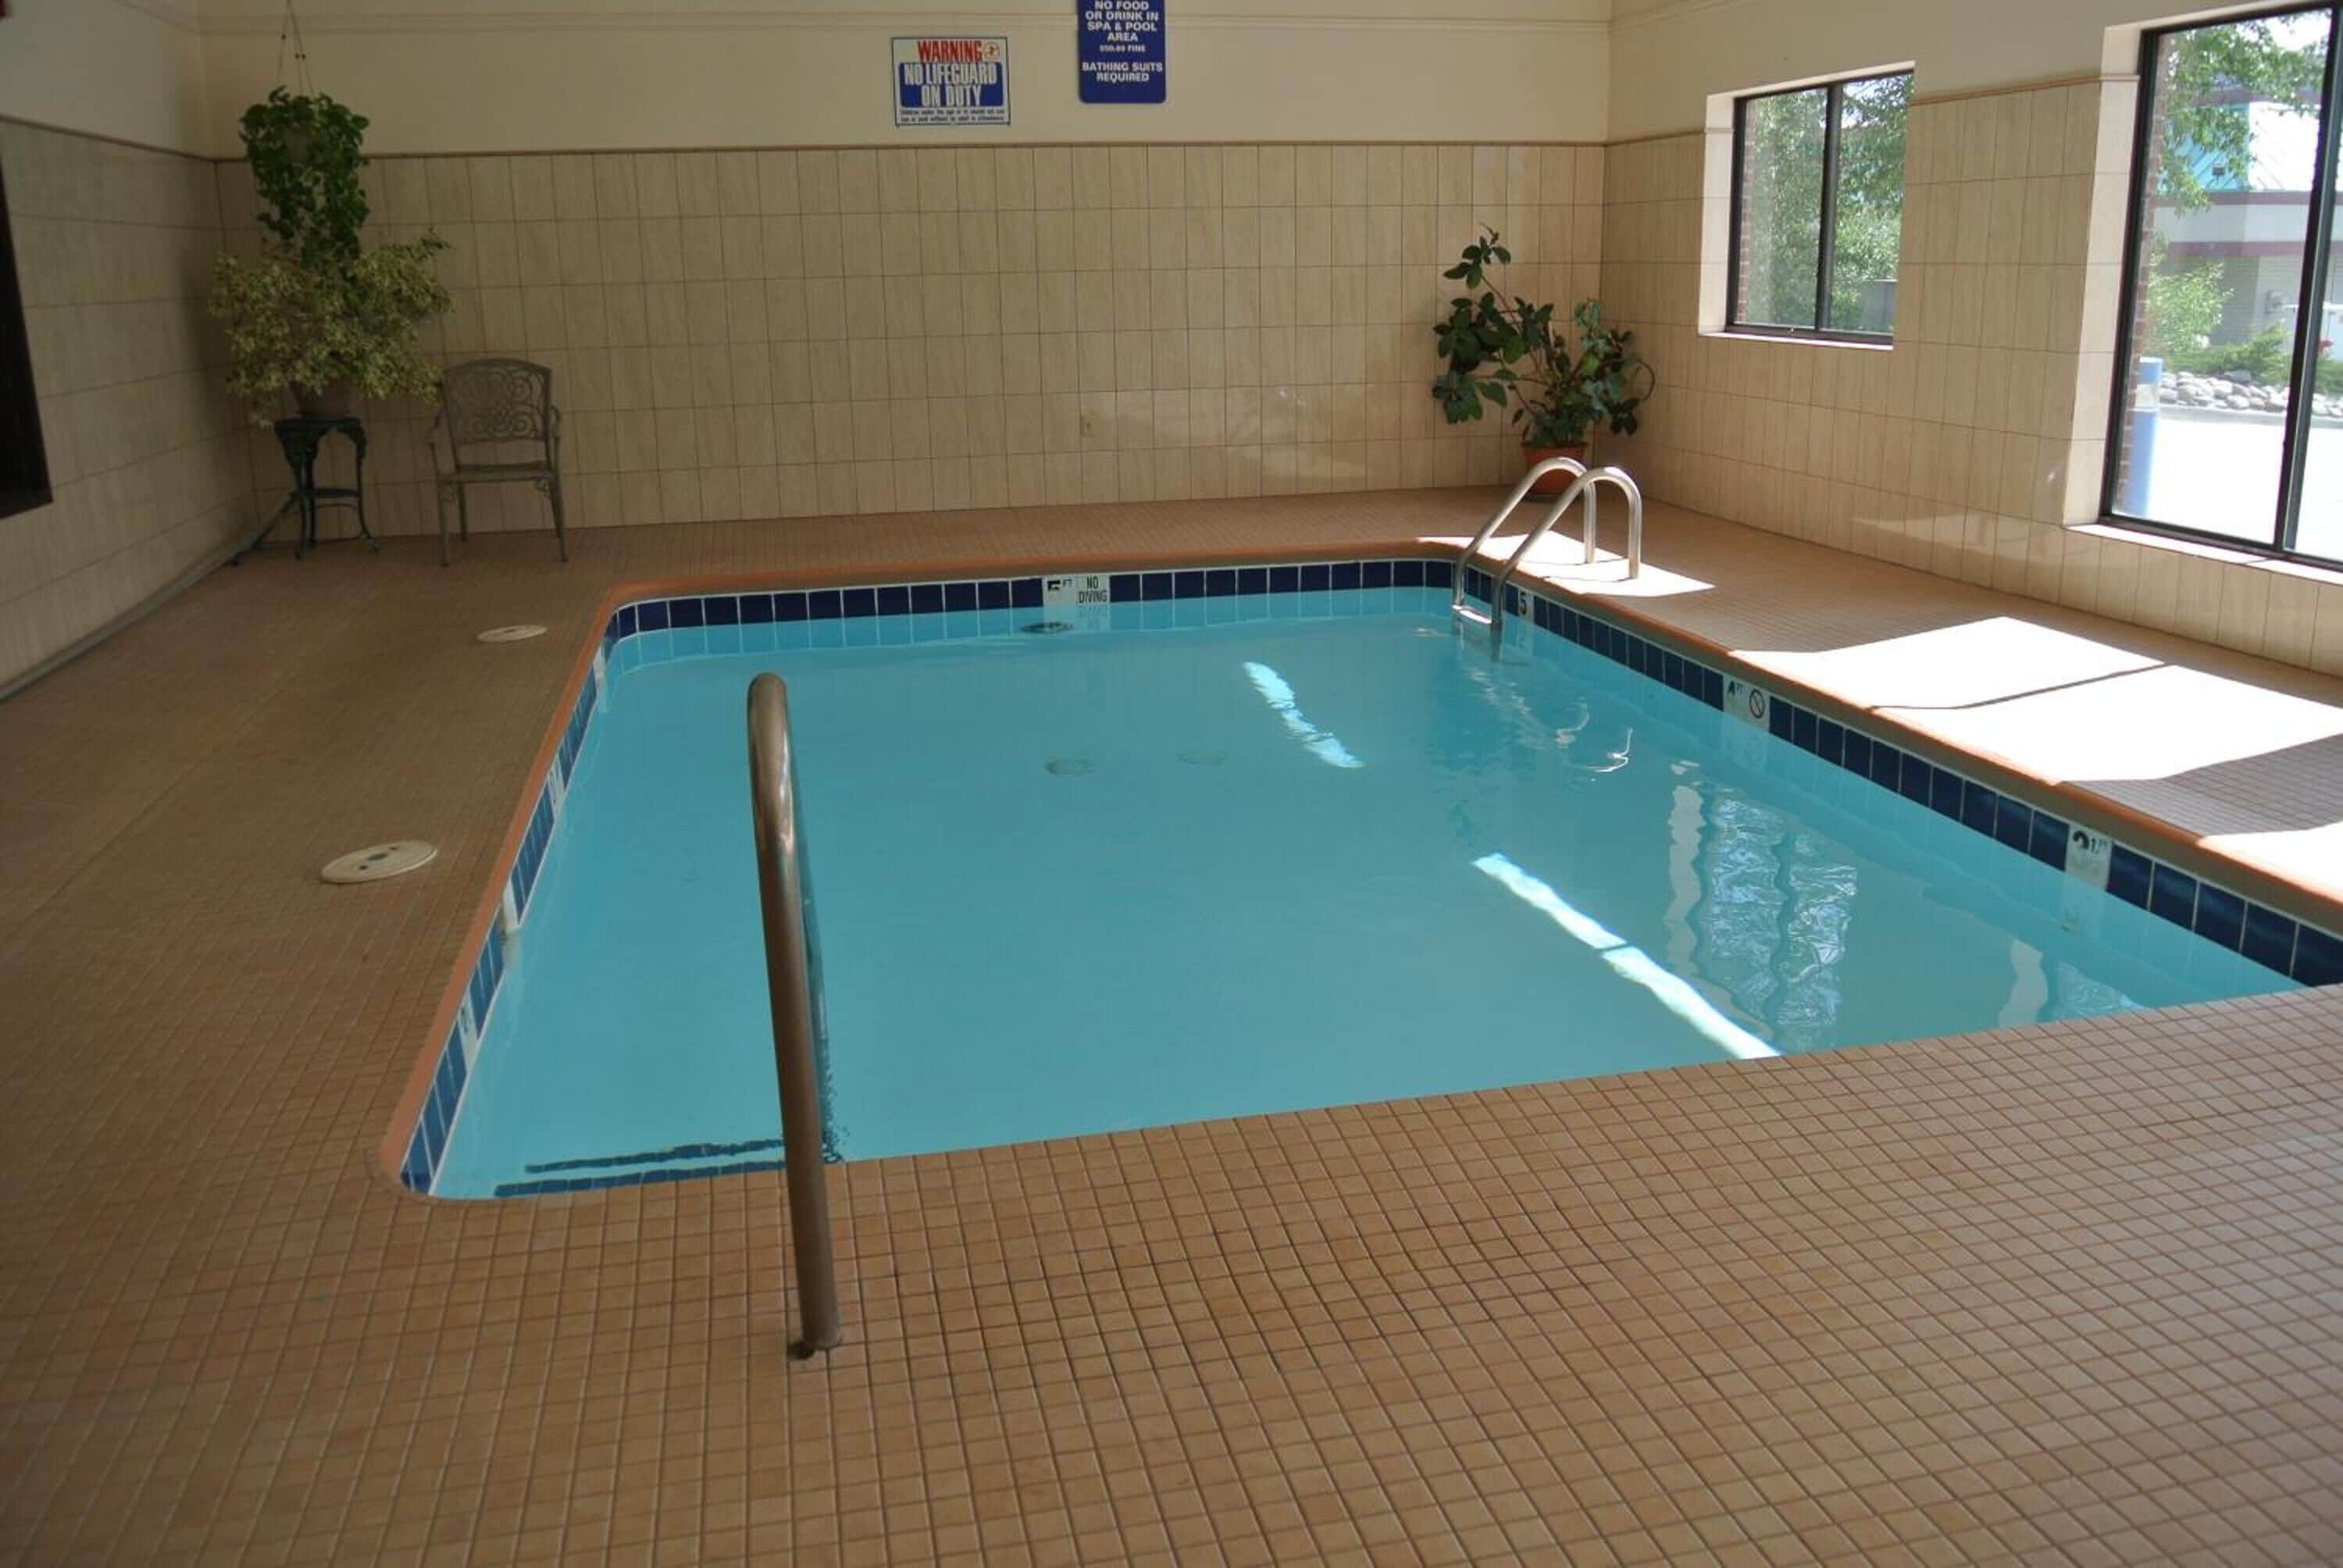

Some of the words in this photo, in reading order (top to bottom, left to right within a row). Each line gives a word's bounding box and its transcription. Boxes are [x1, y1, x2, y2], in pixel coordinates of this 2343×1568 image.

[1094, 1, 1113, 10] NO
[1116, 1, 1149, 10] FOOD
[1086, 11, 1102, 20] OR
[1106, 11, 1143, 20] DRINK
[1147, 12, 1158, 21] IN
[1087, 21, 1111, 30] SPA
[1114, 22, 1122, 30] &
[1125, 22, 1157, 31] POOL
[1107, 32, 1138, 41] AREA
[917, 40, 982, 62] WARNING
[1082, 62, 1129, 72] BATHING
[1132, 62, 1163, 72] SUITS
[904, 62, 923, 85] NO
[925, 62, 997, 85] LIFEGUARD
[1097, 72, 1150, 84] REQUIRED
[922, 84, 941, 108] ON
[945, 84, 981, 108] DUTY
[1086, 576, 1099, 589] NO
[1079, 590, 1107, 604] DIVING
